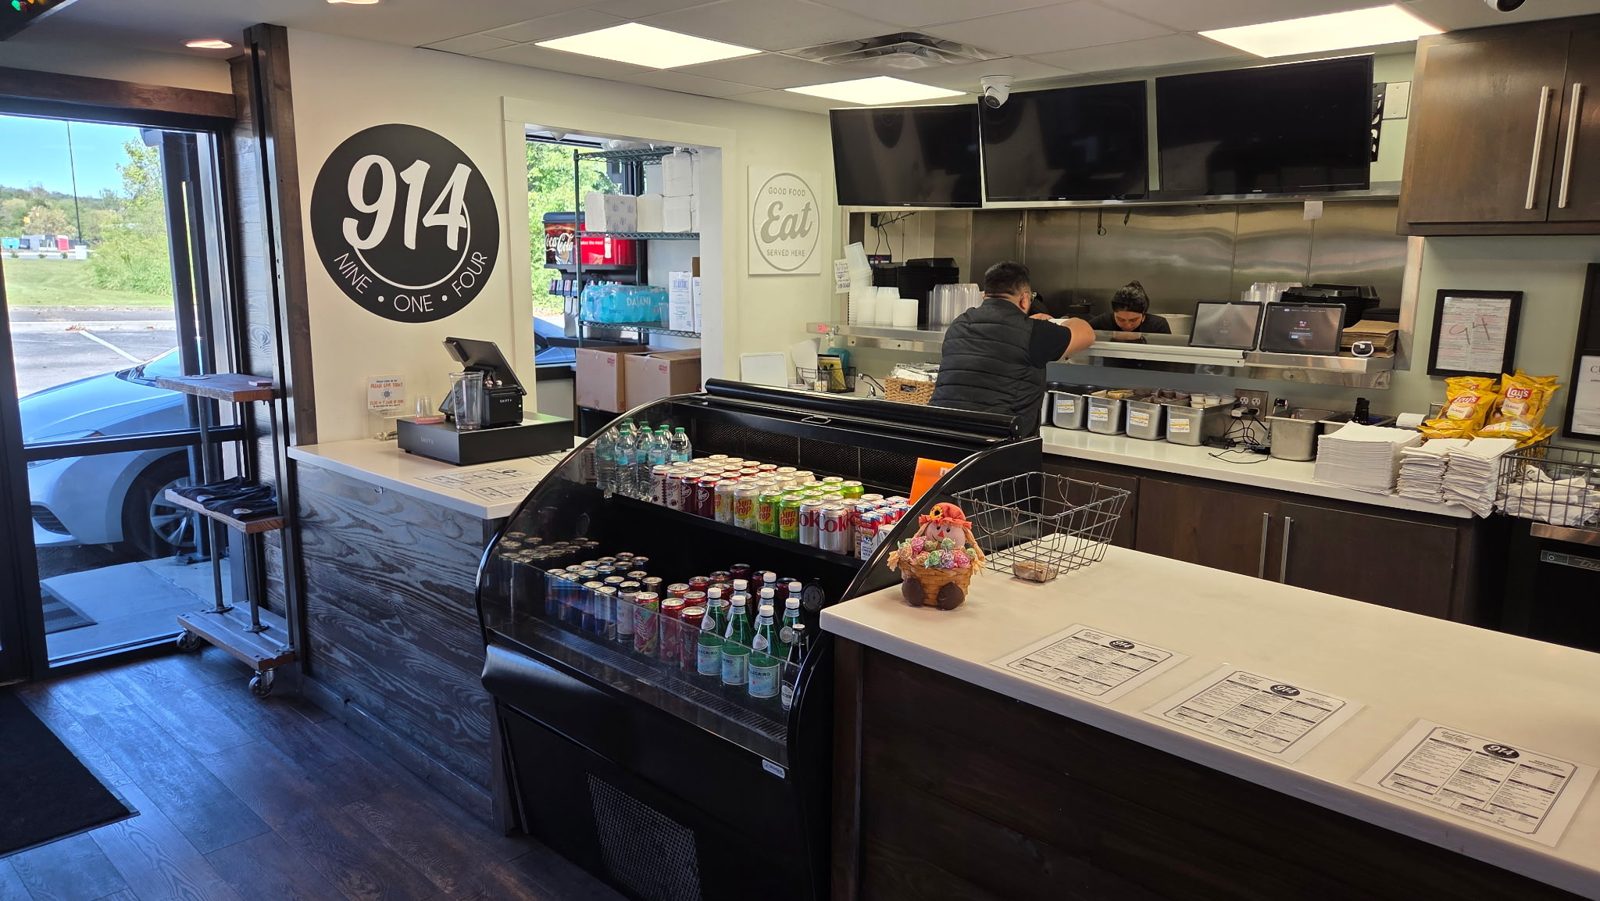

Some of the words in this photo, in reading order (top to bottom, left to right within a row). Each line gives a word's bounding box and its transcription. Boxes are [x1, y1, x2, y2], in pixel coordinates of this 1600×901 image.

[768, 187, 787, 195] GOOD
[788, 188, 806, 197] FOOD
[342, 154, 473, 250] 914
[760, 200, 813, 244] Eat
[766, 248, 790, 257] SERVED
[790, 249, 806, 257] HERE
[334, 252, 373, 295] NINE
[393, 294, 434, 312] ONE
[451, 251, 488, 297] FOUR
[1506, 387, 1529, 399] Lay's
[1487, 744, 1515, 756] 914
